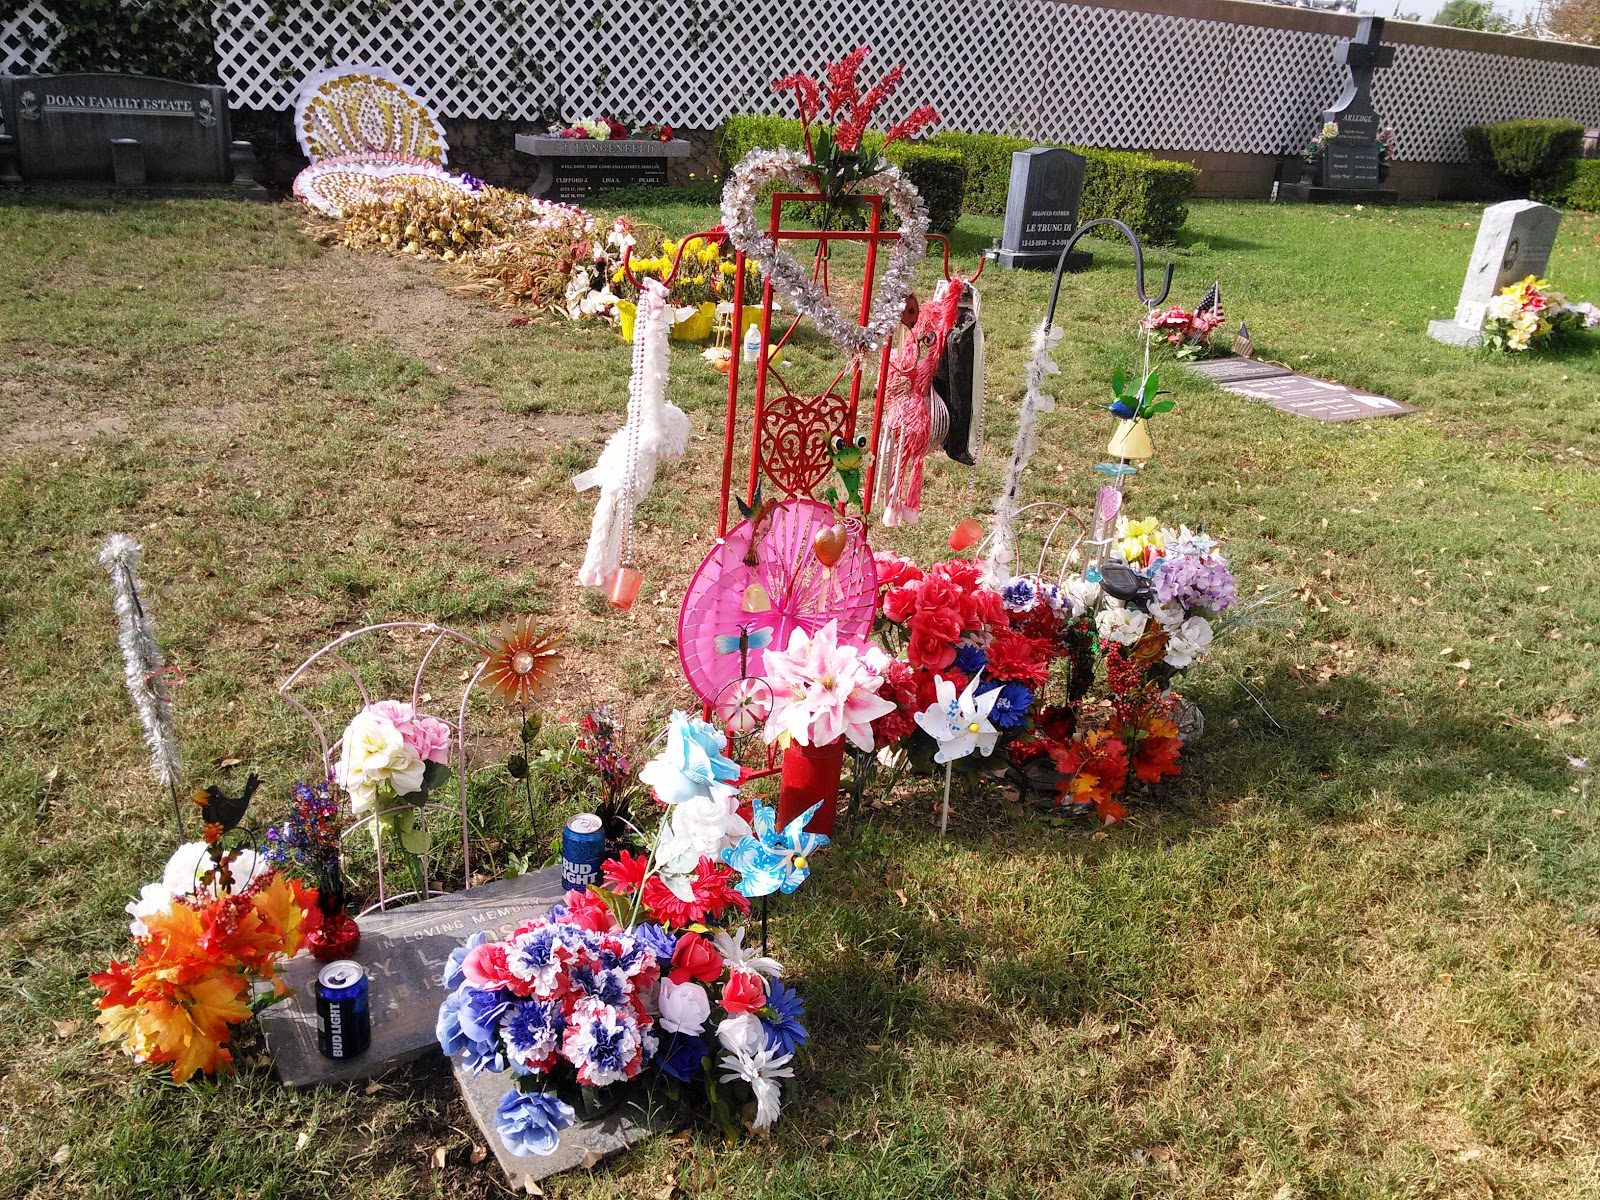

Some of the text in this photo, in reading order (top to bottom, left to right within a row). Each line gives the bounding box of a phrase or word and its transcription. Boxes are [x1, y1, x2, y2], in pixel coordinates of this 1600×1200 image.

[46, 94, 192, 111] DOAN FAMILY ESTATE
[1343, 114, 1373, 123] ARLEDGE
[575, 142, 655, 153] LANGENFELD
[1025, 223, 1072, 232] LE TRUNG DI
[562, 856, 592, 875] BUD
[377, 938, 395, 950] IN
[403, 919, 465, 944] LOVING
[472, 897, 541, 924] MEMORY
[330, 1002, 343, 1058] BUD LIGHT
